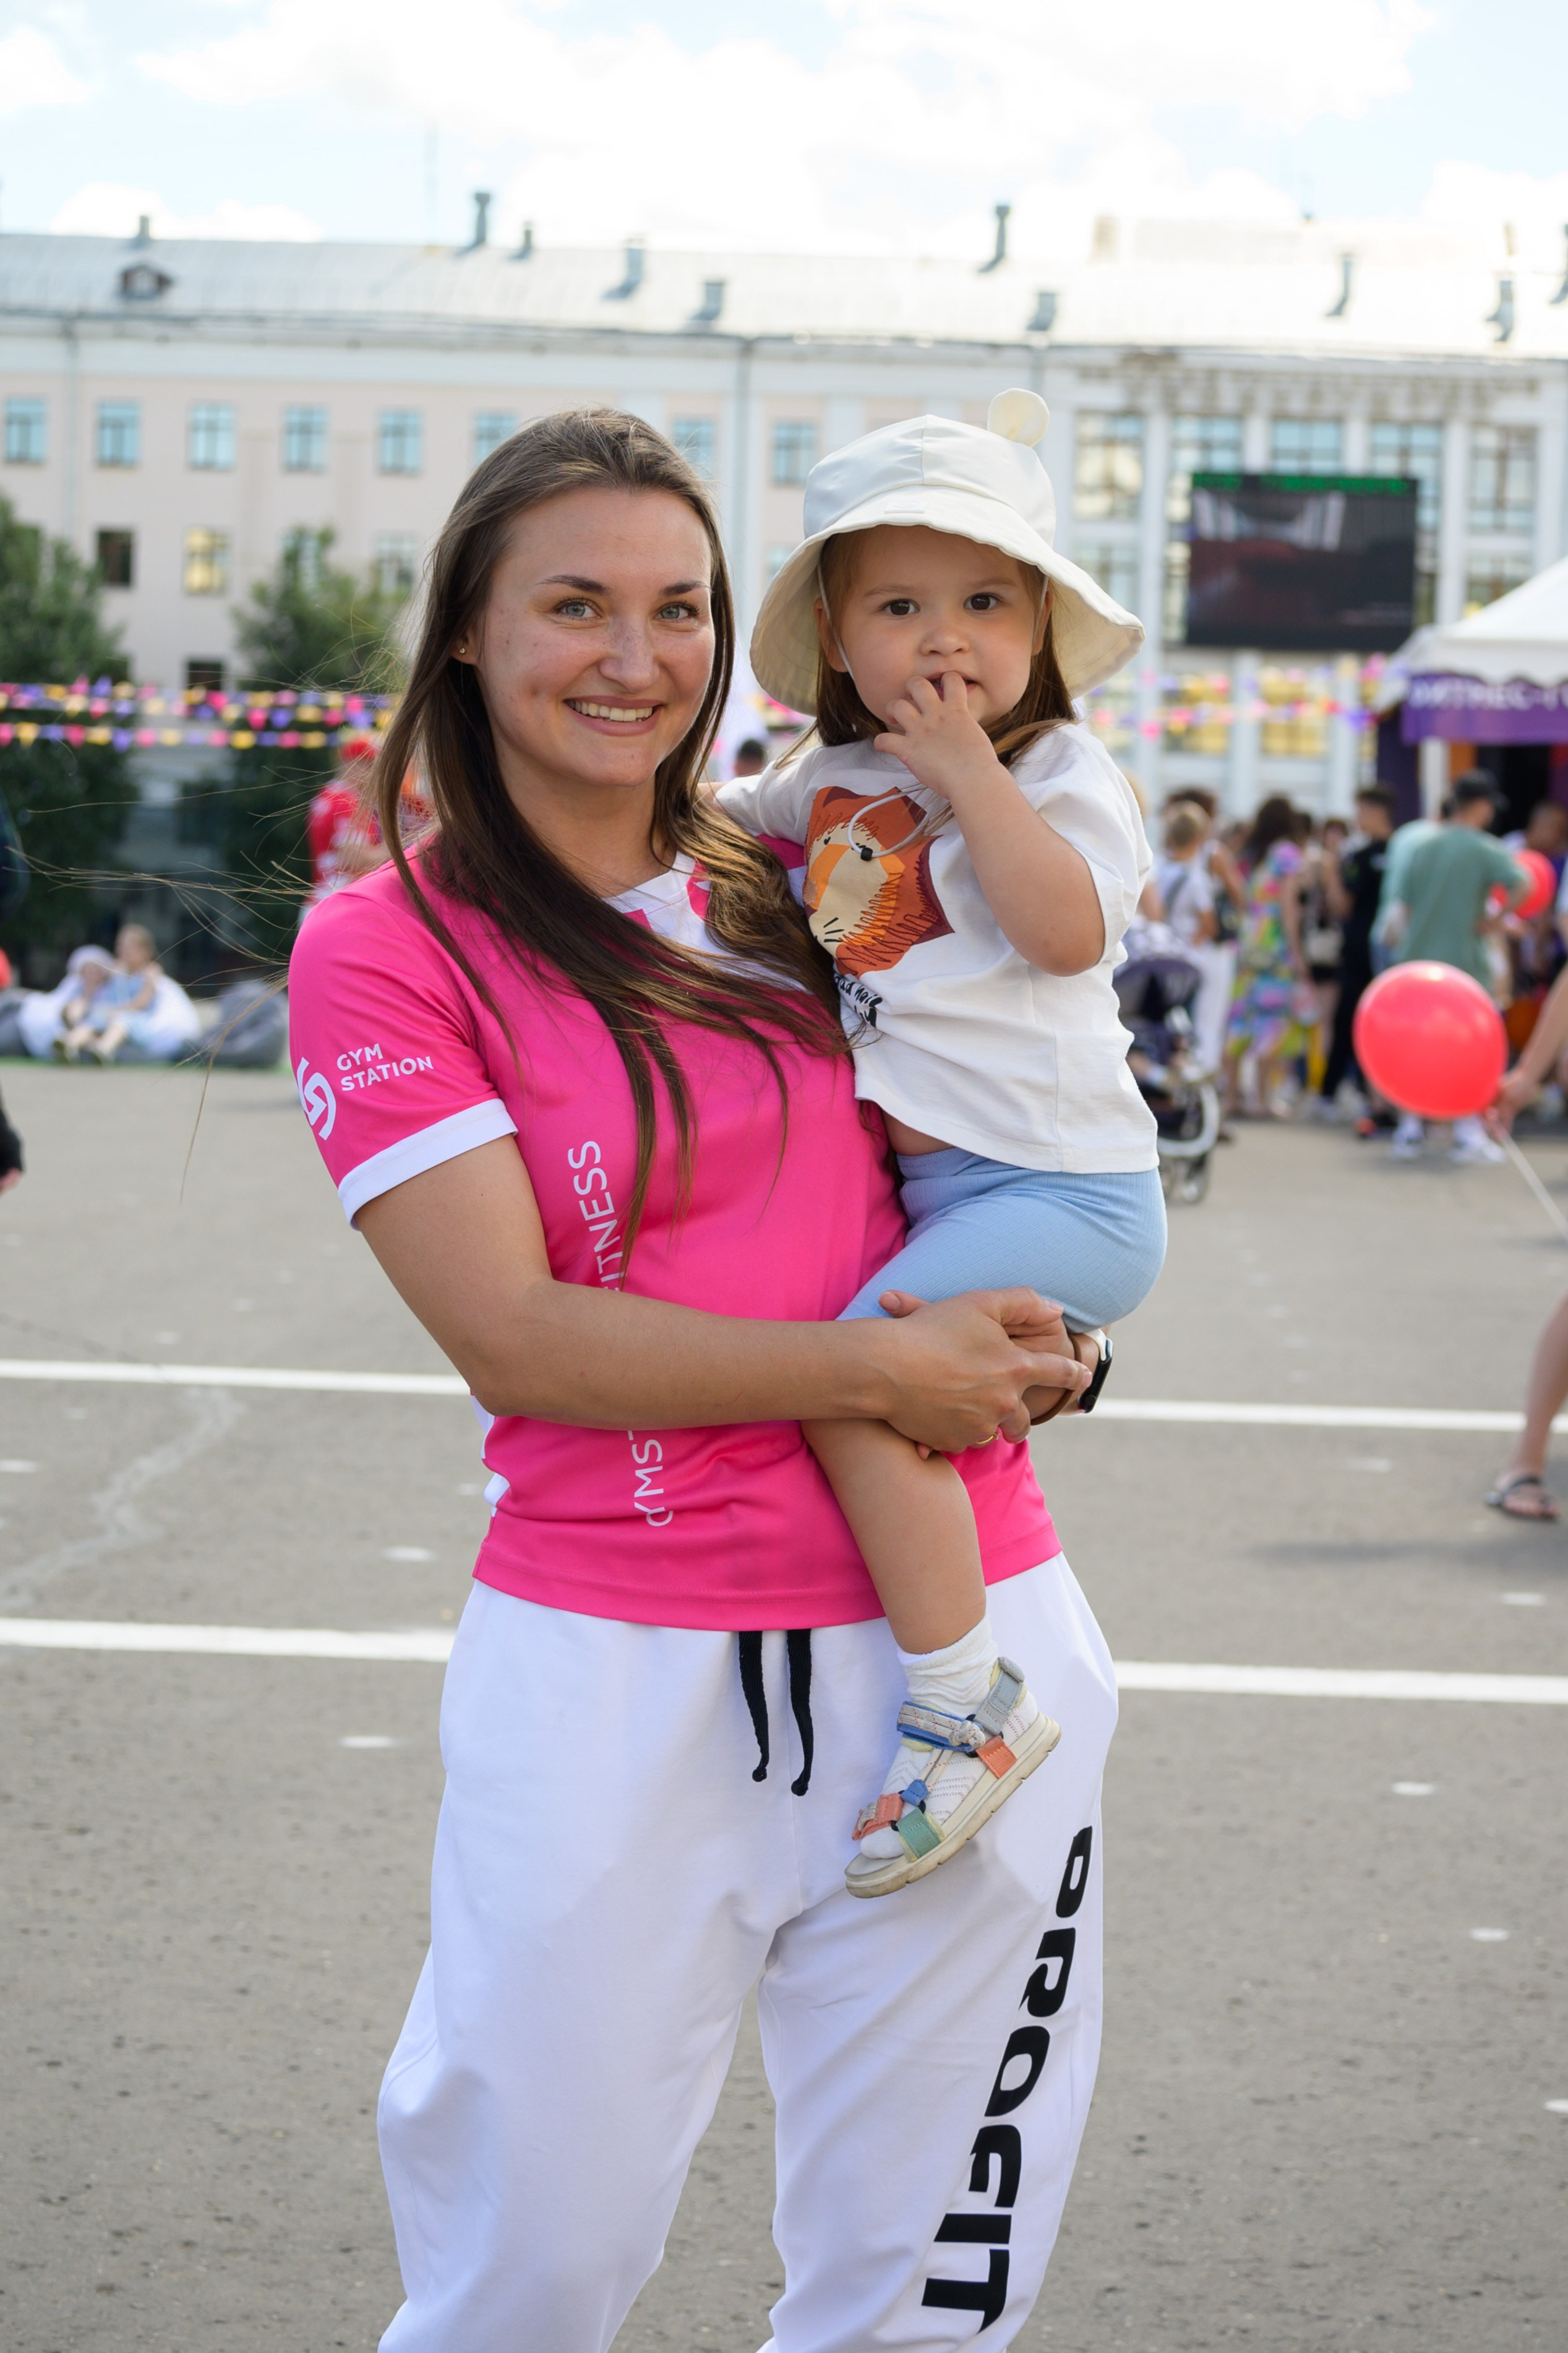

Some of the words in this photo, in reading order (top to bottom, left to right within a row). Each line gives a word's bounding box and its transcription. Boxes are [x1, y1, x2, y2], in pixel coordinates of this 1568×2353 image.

[336, 1043, 383, 1071] GYM
[340, 1056, 434, 1091] STATION
[568, 1140, 627, 1292] ITNESS
